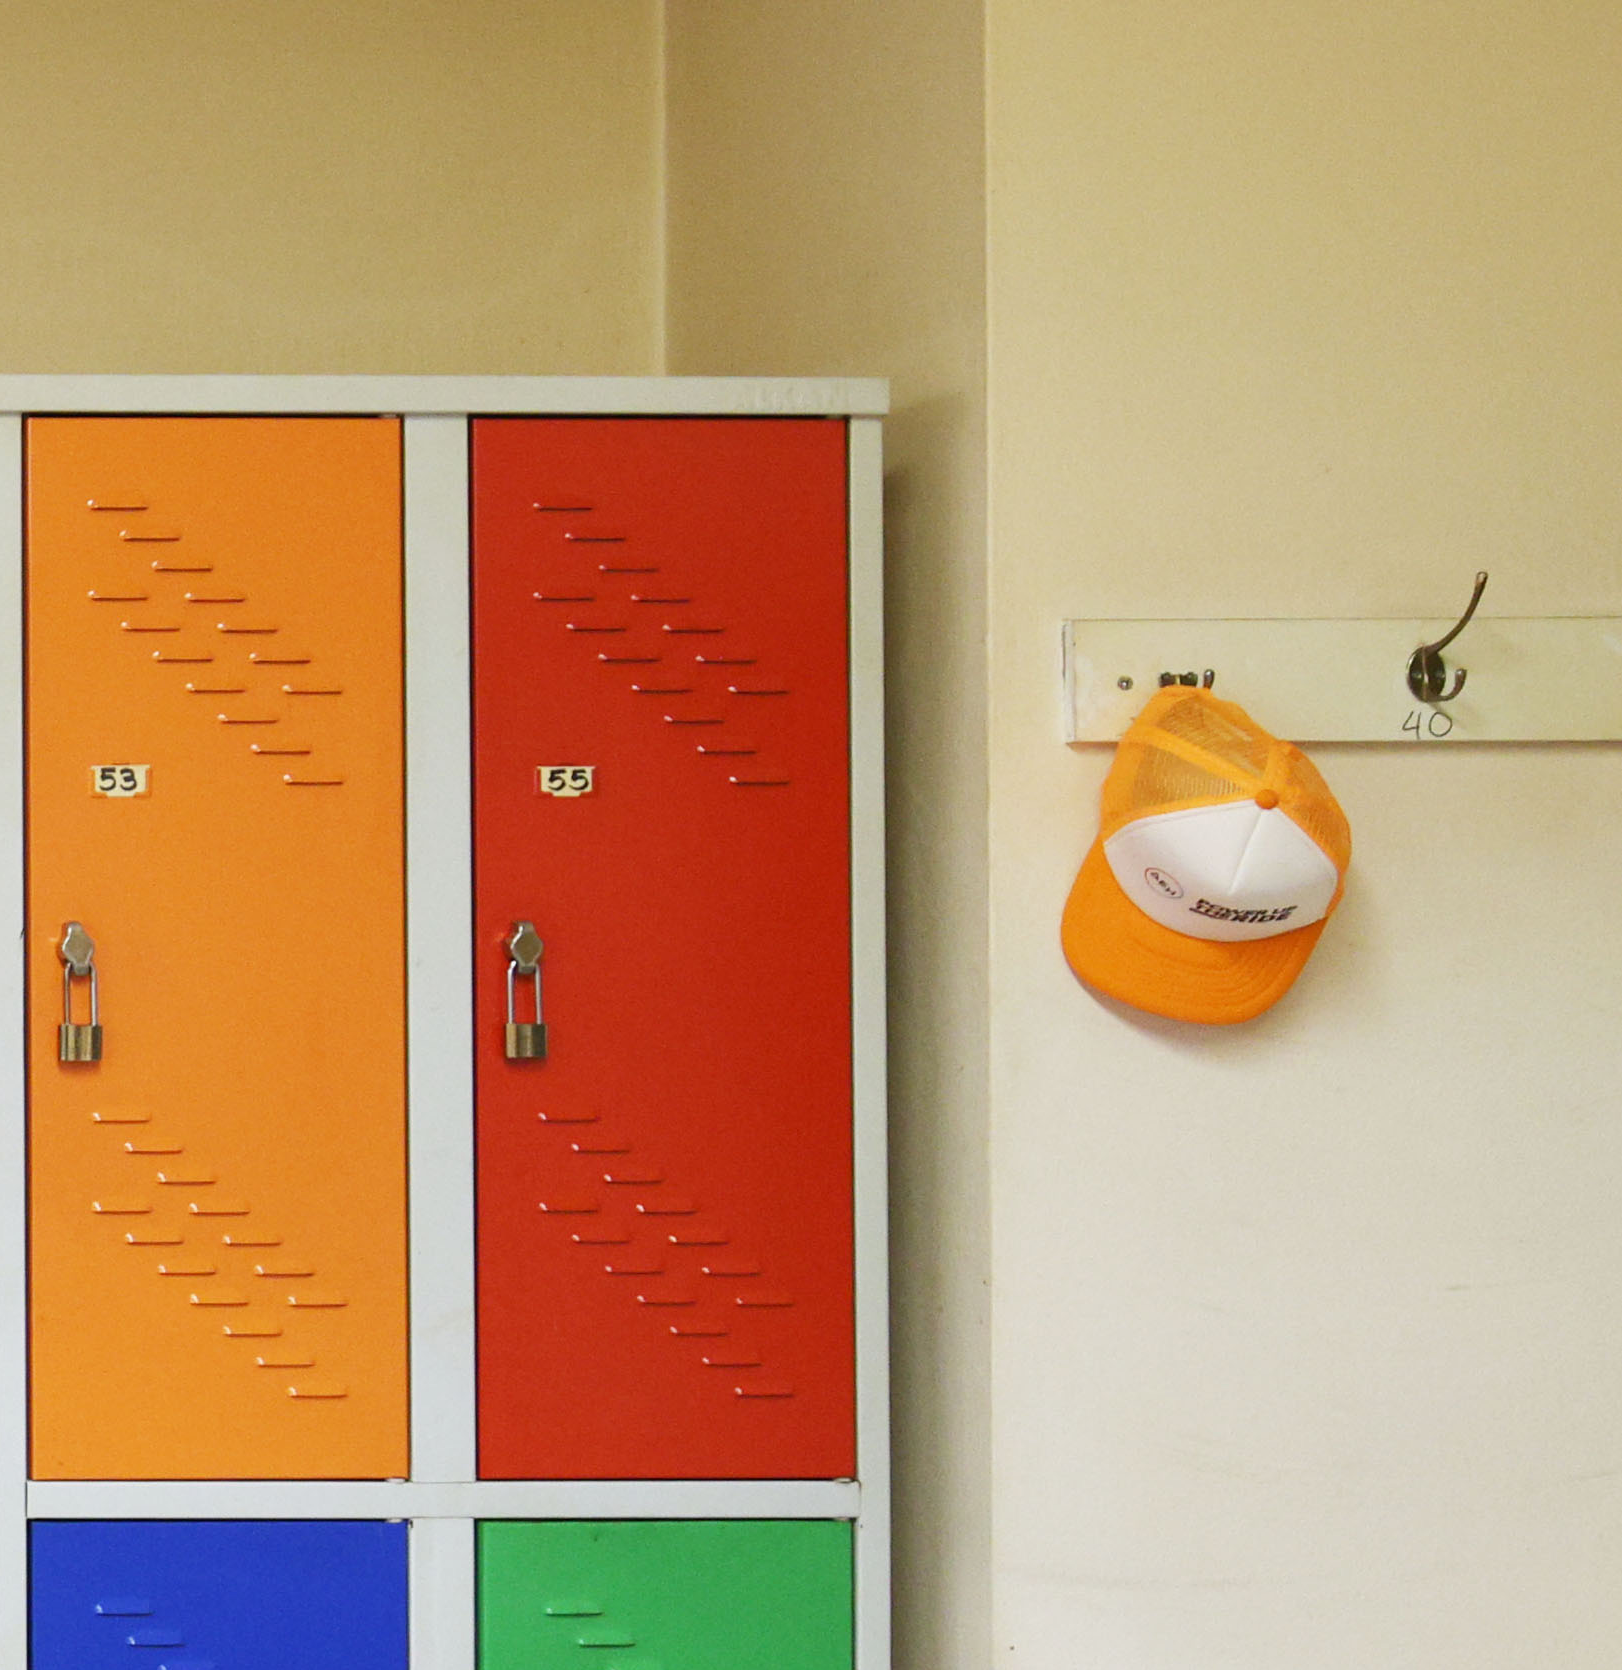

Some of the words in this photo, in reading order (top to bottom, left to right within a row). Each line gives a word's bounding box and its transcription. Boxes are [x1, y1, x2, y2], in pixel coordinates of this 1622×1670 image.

[1401, 711, 1455, 740] 40
[99, 768, 138, 791] 53
[547, 768, 590, 791] 55
